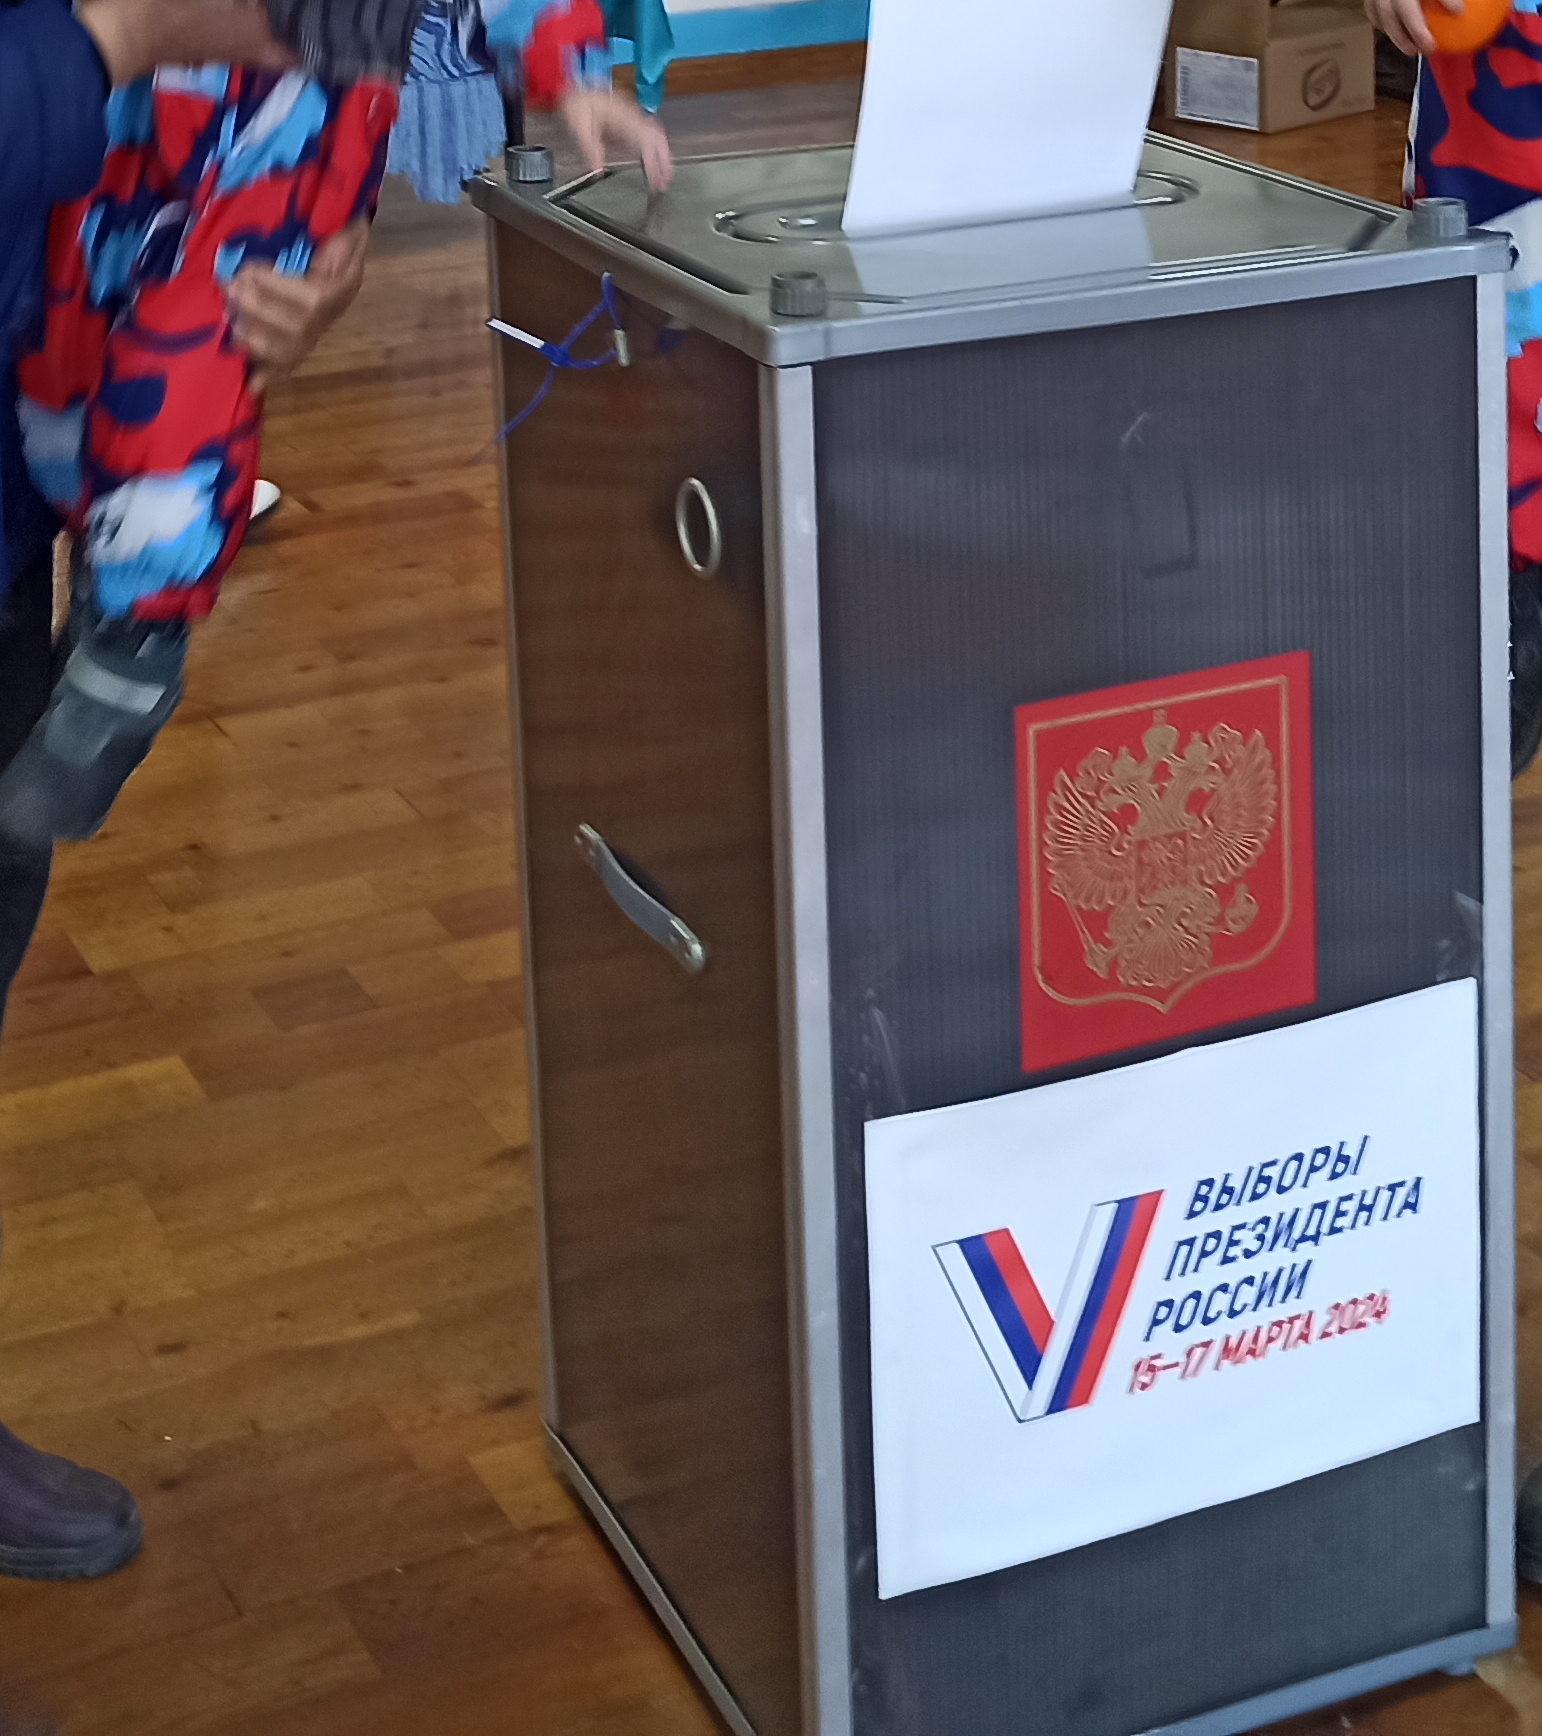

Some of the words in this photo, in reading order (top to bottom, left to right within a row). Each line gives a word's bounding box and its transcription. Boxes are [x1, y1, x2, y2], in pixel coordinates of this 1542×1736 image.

[1183, 1134, 1371, 1220] ВЫБОРЫ
[1162, 1176, 1425, 1281] ПРЕЗИДЕНТА
[1142, 1259, 1314, 1342] РОССИИ
[1212, 1309, 1316, 1371] МАРТА
[1317, 1289, 1392, 1341] 2024
